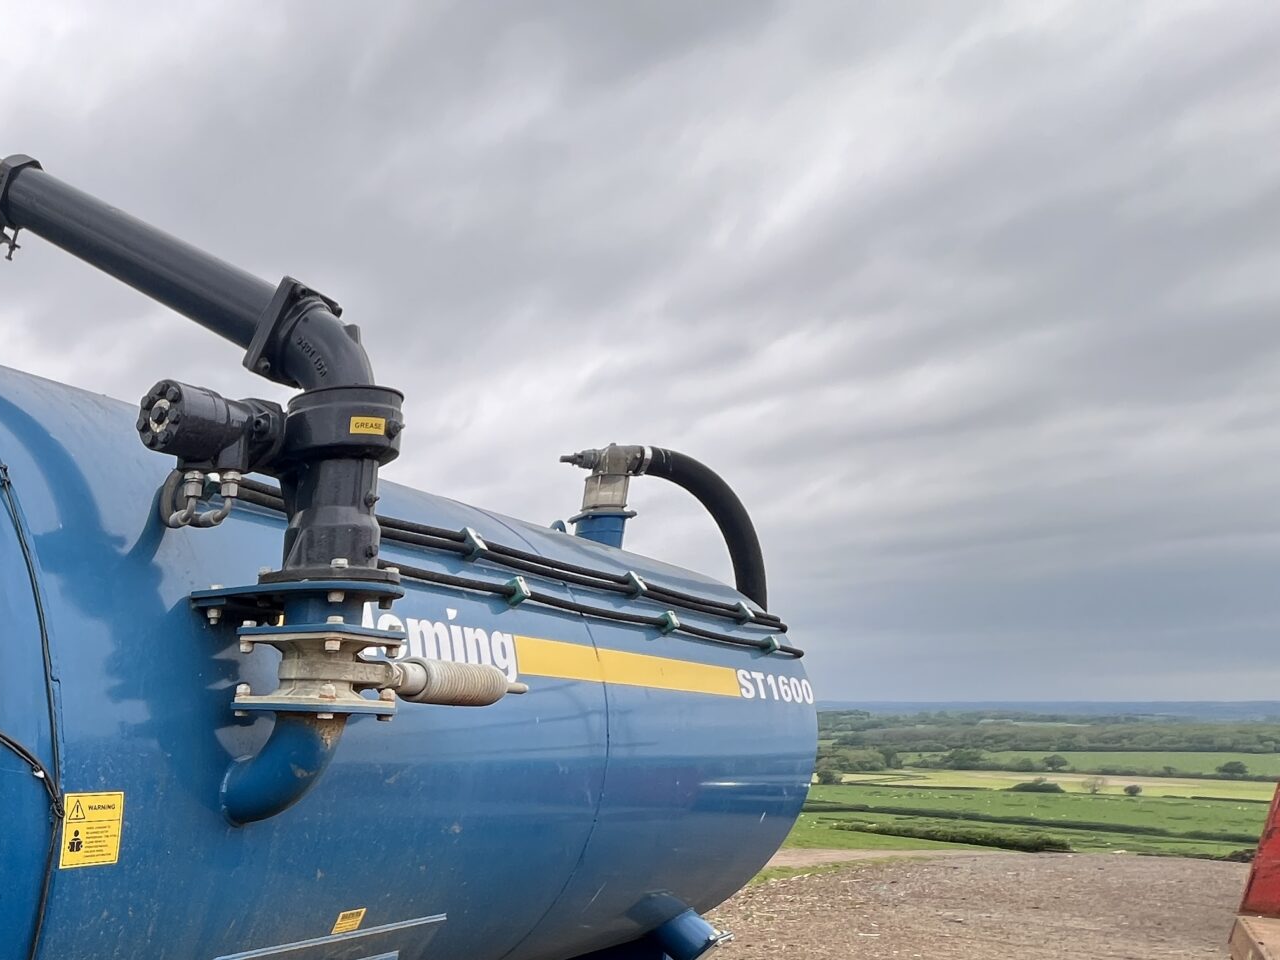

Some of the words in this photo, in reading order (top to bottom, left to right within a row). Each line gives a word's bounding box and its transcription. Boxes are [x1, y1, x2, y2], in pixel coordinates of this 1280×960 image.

[354, 422, 383, 430] GREASE
[361, 601, 519, 683] leming
[736, 668, 814, 704] ST1600
